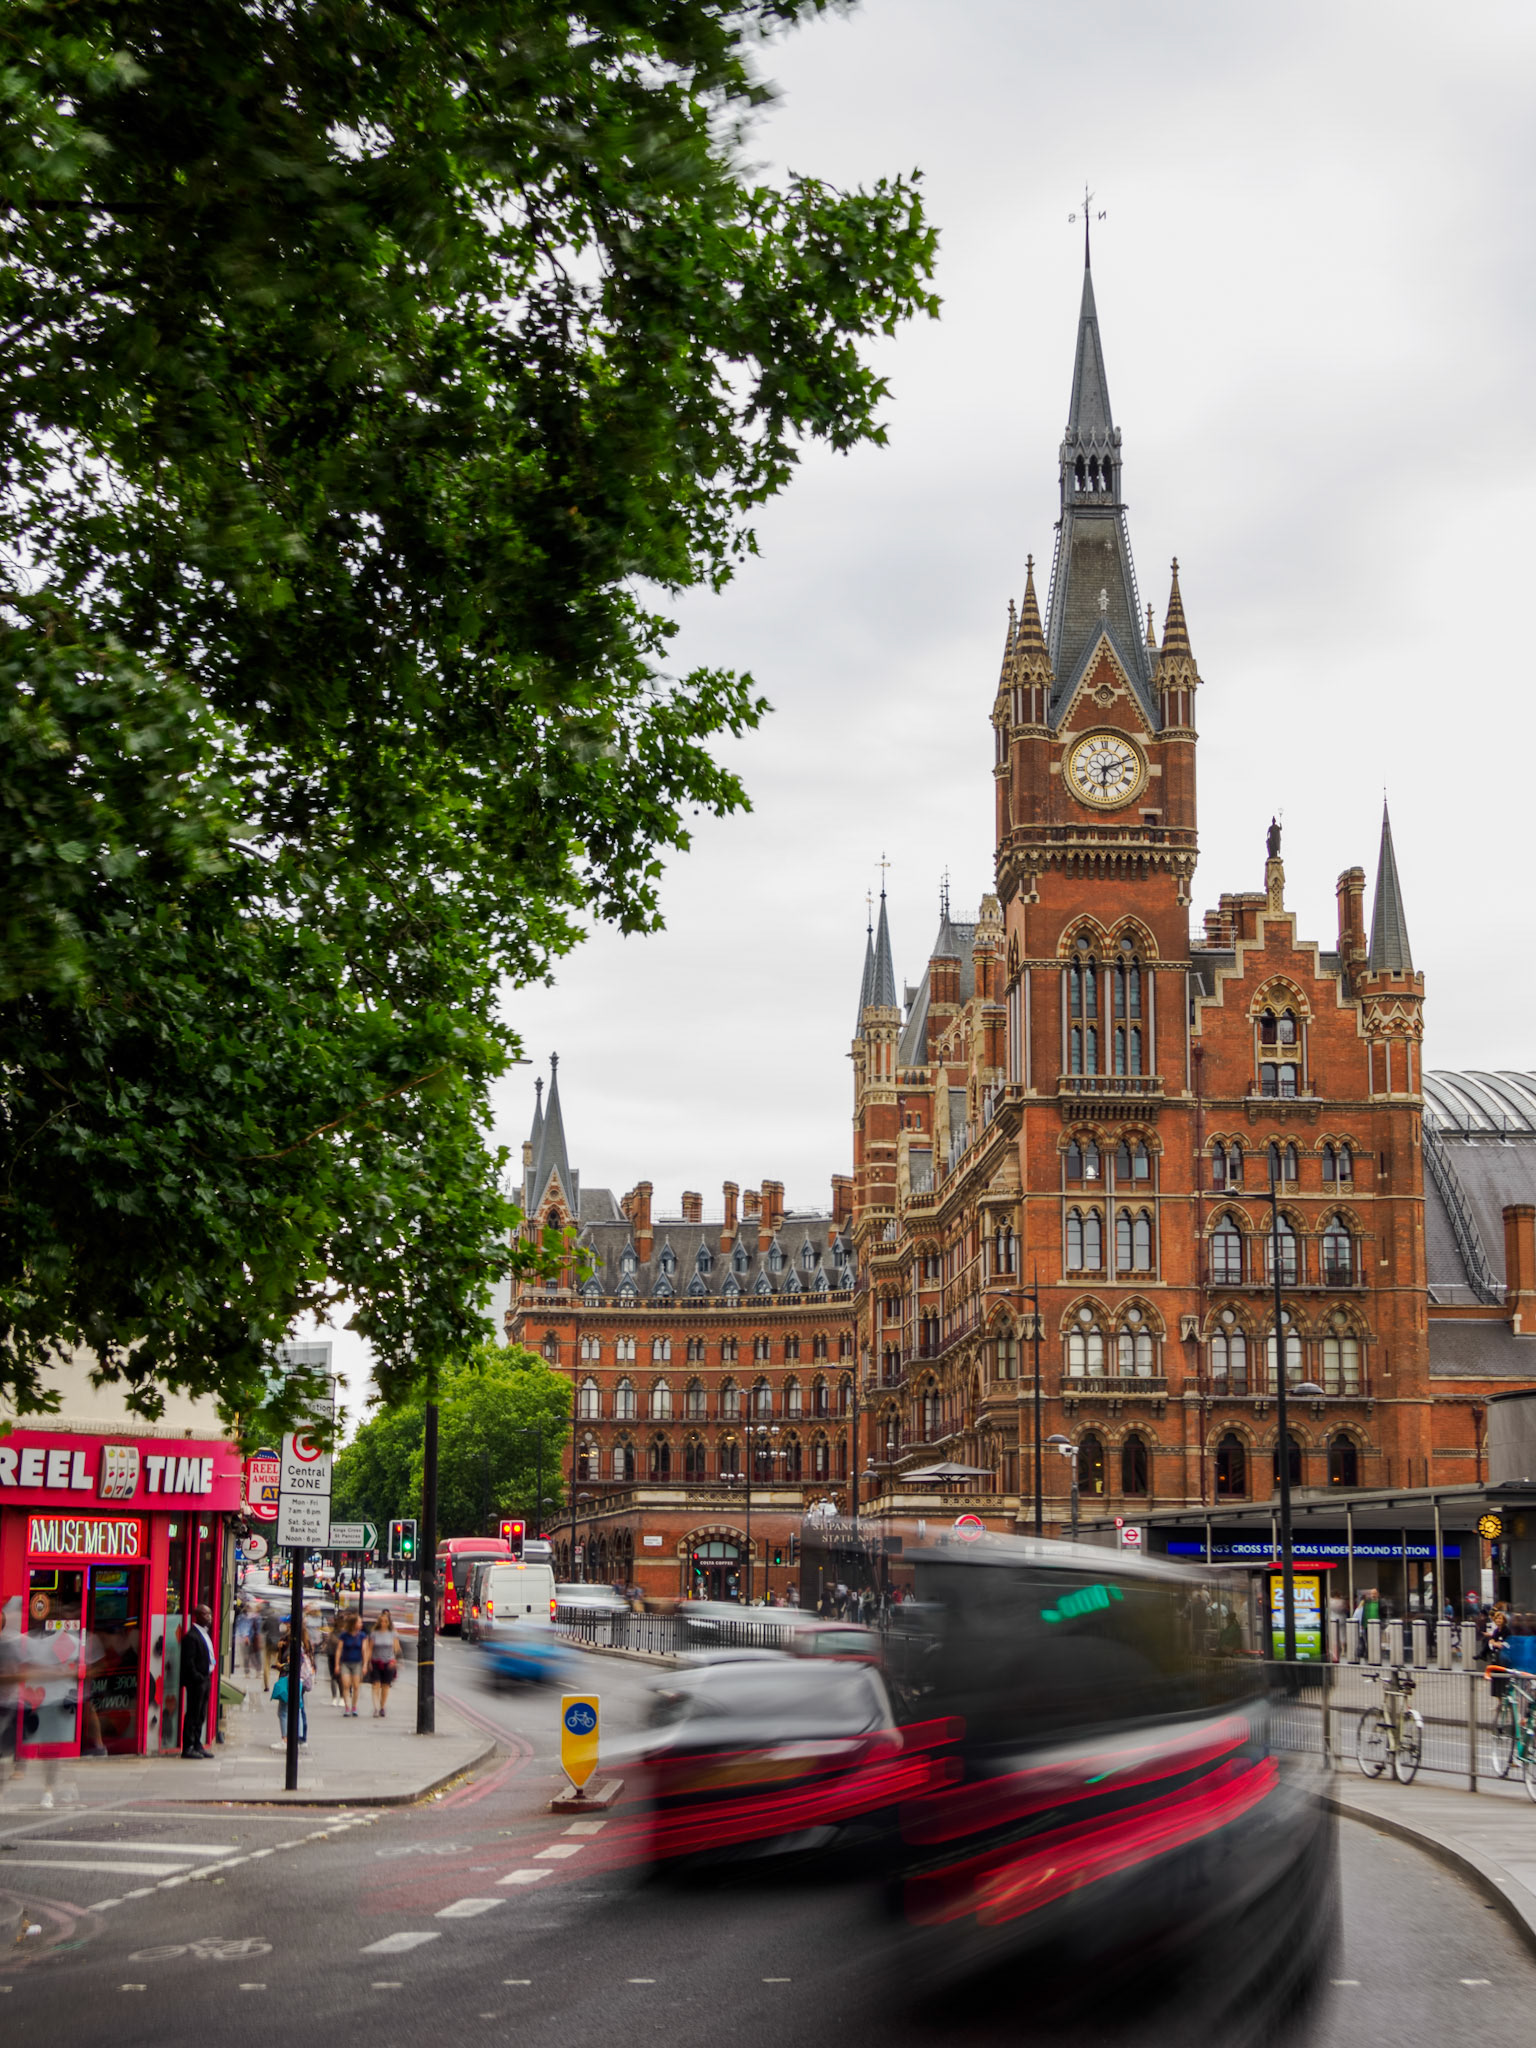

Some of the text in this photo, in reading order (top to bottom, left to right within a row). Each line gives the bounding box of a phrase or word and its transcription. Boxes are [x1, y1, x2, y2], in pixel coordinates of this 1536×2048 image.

[0, 1447, 94, 1490] REEL
[252, 1463, 279, 1474] REEL
[287, 1465, 325, 1477] Central
[146, 1455, 214, 1494] TIME
[252, 1475, 280, 1484] AMUSE
[290, 1478, 321, 1489] ZONE
[262, 1488, 280, 1499] AT
[291, 1498, 306, 1506] Mon
[30, 1519, 138, 1556] AMUSEMENTS
[1200, 1544, 1230, 1553] KNG'S
[1231, 1545, 1262, 1554] CROSS
[1319, 1545, 1391, 1555] UNDERGROUND
[1293, 1587, 1316, 1601] UK
